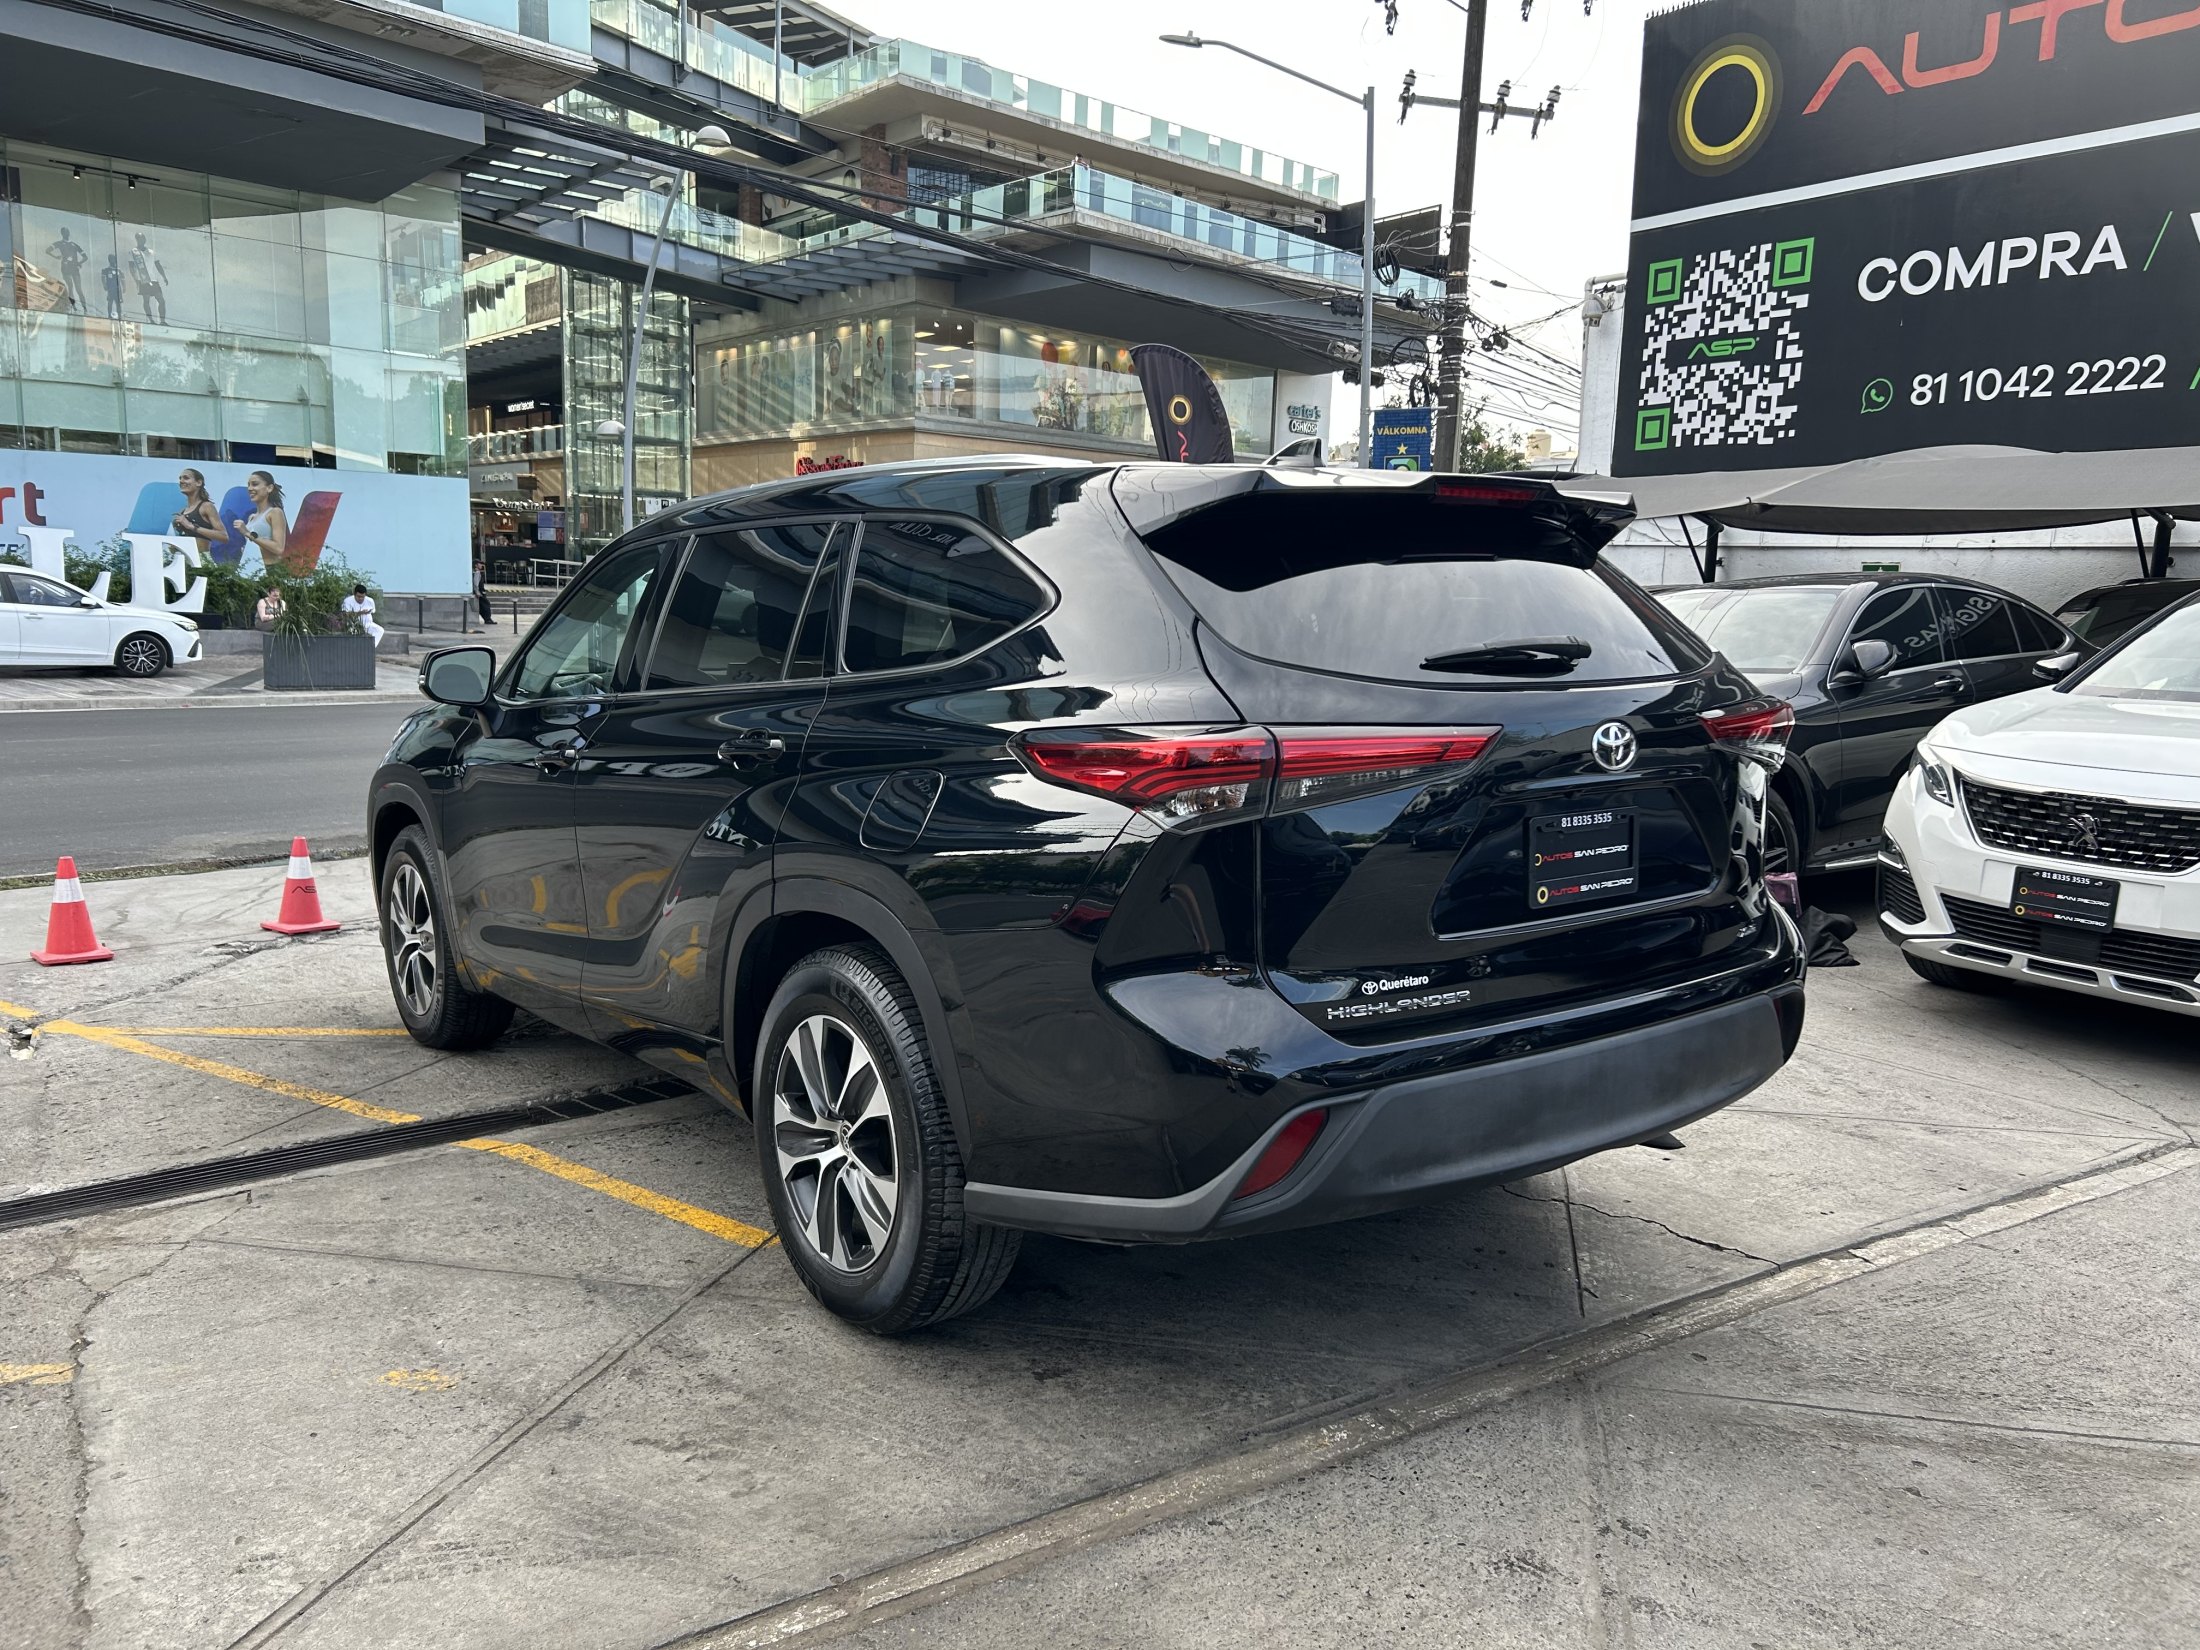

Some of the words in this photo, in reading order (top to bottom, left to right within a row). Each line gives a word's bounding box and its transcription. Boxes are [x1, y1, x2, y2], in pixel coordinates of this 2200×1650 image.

[1857, 224, 2128, 302] COMPRA
[1688, 337, 1757, 360] ASP
[1910, 373, 1948, 406] 81
[1958, 364, 2054, 402] 1042
[2064, 354, 2167, 396] 2222
[1377, 425, 1428, 436] VÄLKOMNA
[1561, 816, 1571, 827] 81
[1573, 815, 1592, 826] 8335
[1593, 812, 1612, 823] 3535
[1542, 852, 1573, 862] AUTOS
[1574, 848, 1595, 858] SAN
[1595, 844, 1629, 855] PEDRO
[2042, 871, 2051, 879] 81
[2052, 872, 2071, 882] 8335
[2071, 875, 2091, 885] 3535
[1549, 886, 1579, 897] AUTOS
[1580, 882, 1600, 892] SAN
[1601, 878, 1634, 889] PEDRO
[2056, 894, 2076, 902] SAN
[2077, 897, 2111, 907] PEDRO
[2054, 914, 2074, 922] SAN
[2074, 917, 2107, 927] PEDRO
[1379, 975, 1429, 991] Querétaro
[1327, 990, 1471, 1020] HIGHLANDER
